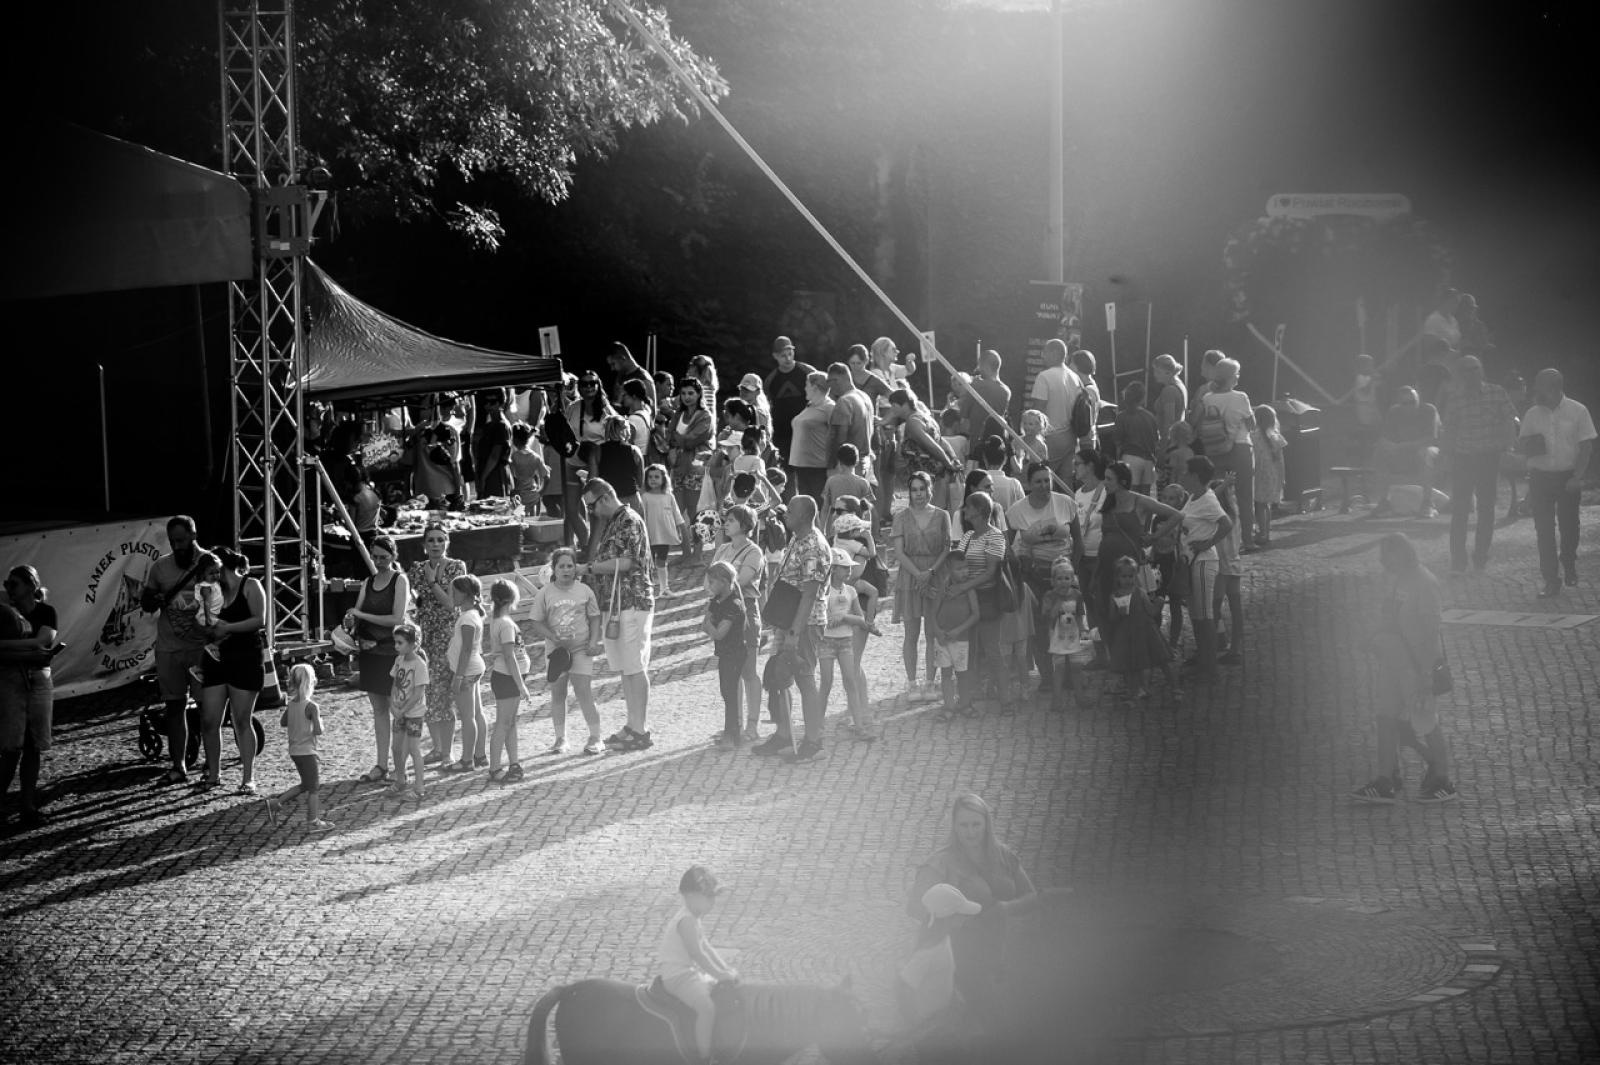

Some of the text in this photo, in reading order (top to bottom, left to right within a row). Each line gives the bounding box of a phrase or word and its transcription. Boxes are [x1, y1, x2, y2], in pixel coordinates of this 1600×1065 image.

[85, 541, 162, 604] ZAMEK PIASTO
[101, 641, 157, 673] RACIBO
